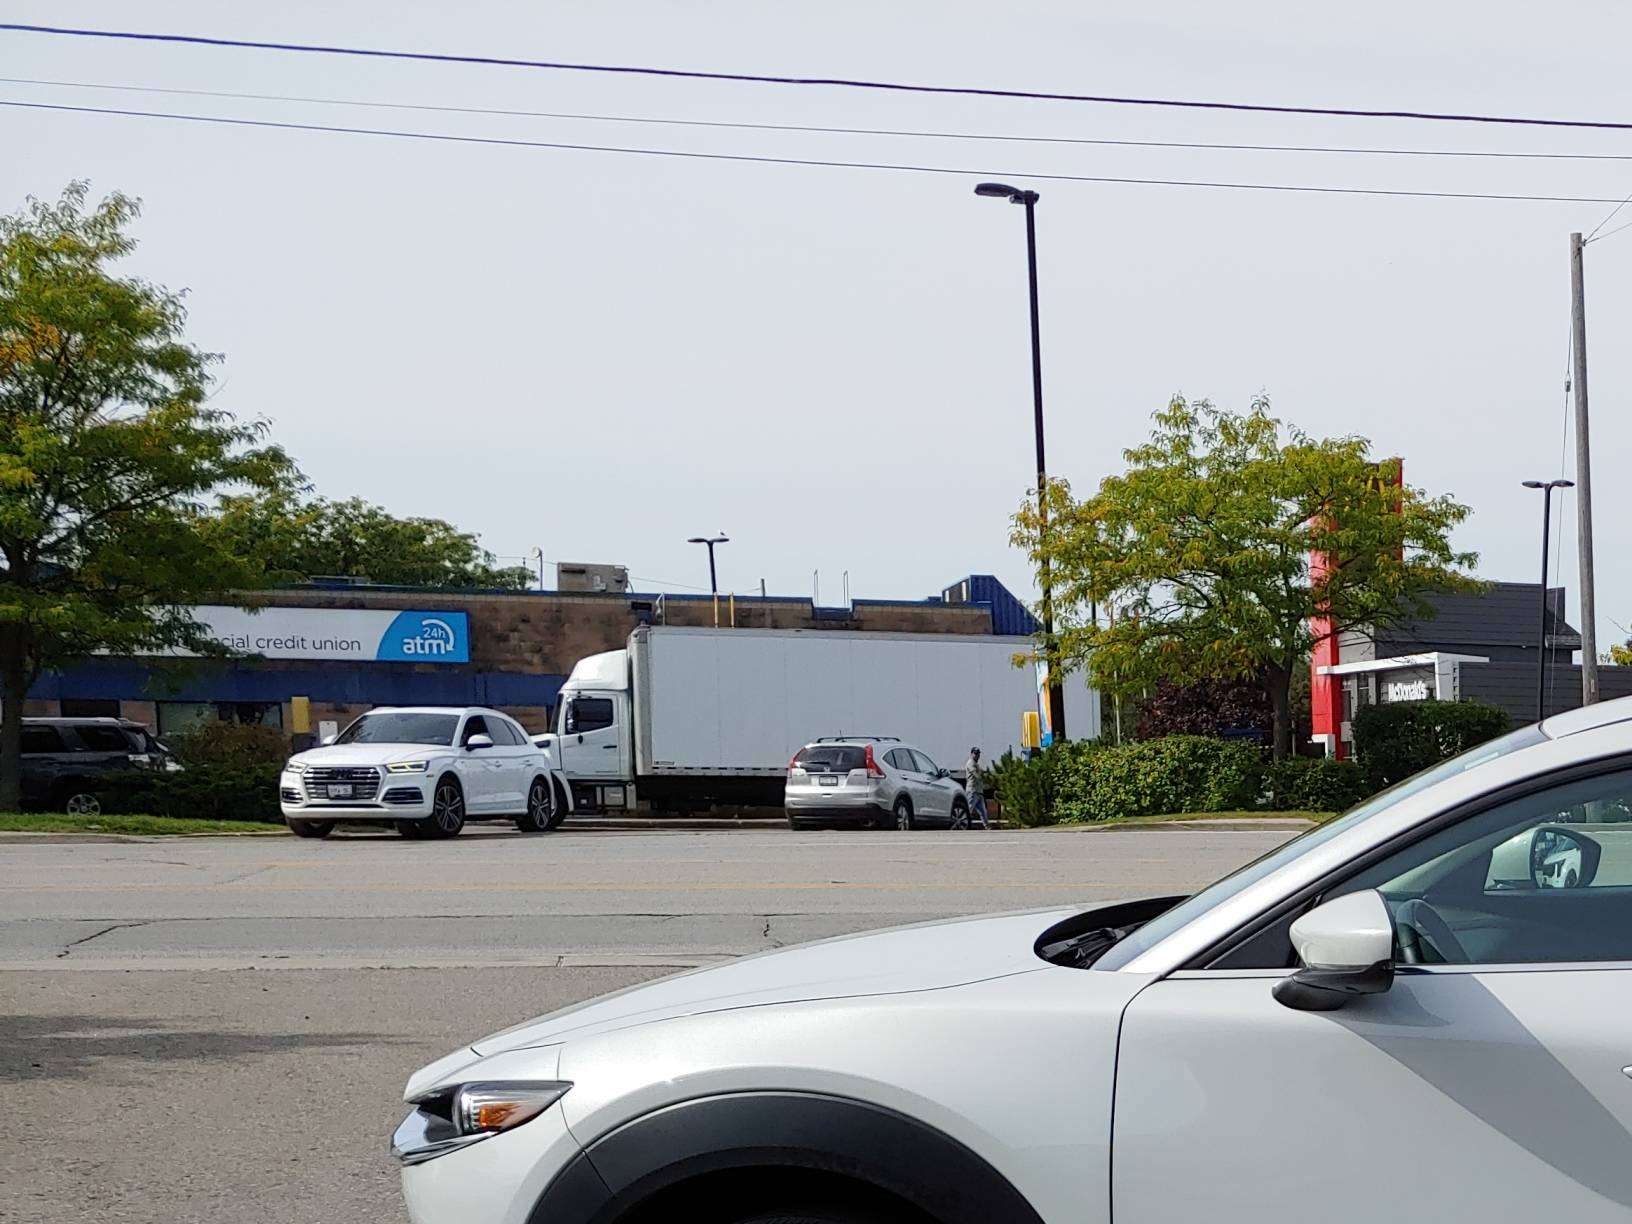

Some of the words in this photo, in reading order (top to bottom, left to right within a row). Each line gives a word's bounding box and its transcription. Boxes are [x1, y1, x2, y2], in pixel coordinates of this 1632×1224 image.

[423, 627, 446, 639] 24h
[255, 634, 308, 650] credit
[312, 636, 361, 651] union
[403, 636, 446, 655] atm
